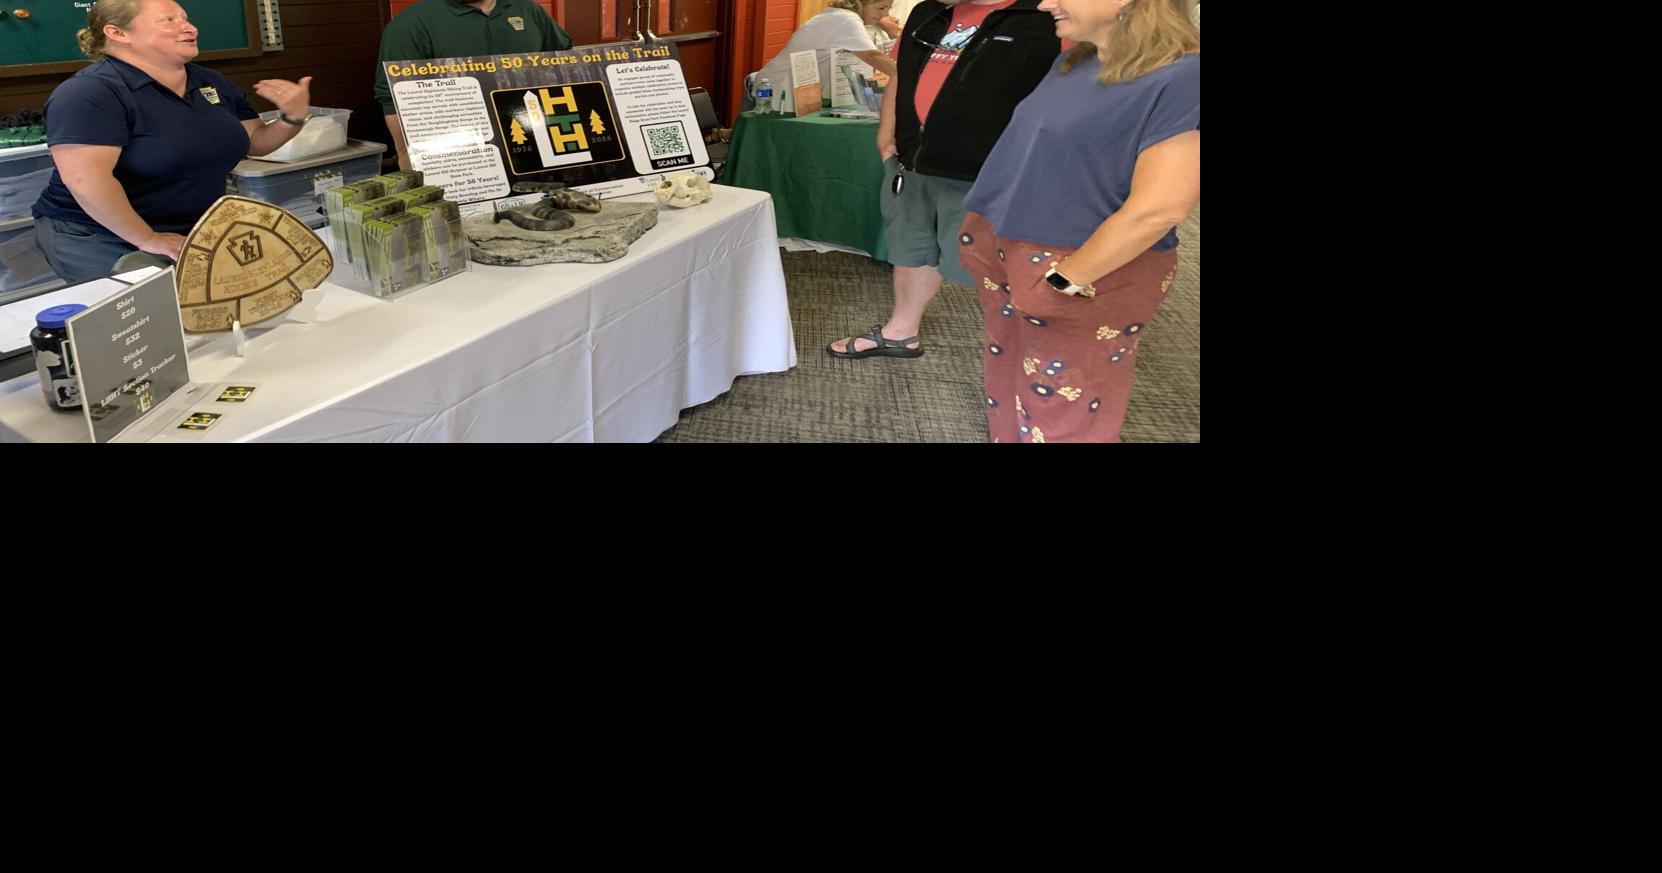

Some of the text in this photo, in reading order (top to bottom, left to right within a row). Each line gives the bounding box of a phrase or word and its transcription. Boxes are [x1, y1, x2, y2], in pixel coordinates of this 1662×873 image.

[388, 46, 670, 76] Celebrating 50 Years on the Trail
[634, 64, 670, 72] Celebrate!
[421, 147, 494, 160] Commemoration
[656, 158, 677, 168] SCAN
[116, 296, 134, 310] Shirt
[121, 306, 136, 320] $20
[112, 316, 150, 341] Sweatshirt
[126, 332, 140, 345] $32
[123, 344, 149, 363] Sticker
[133, 358, 142, 369] $3
[123, 372, 149, 392] Section
[150, 354, 176, 374] Tracker
[136, 382, 150, 396] $40
